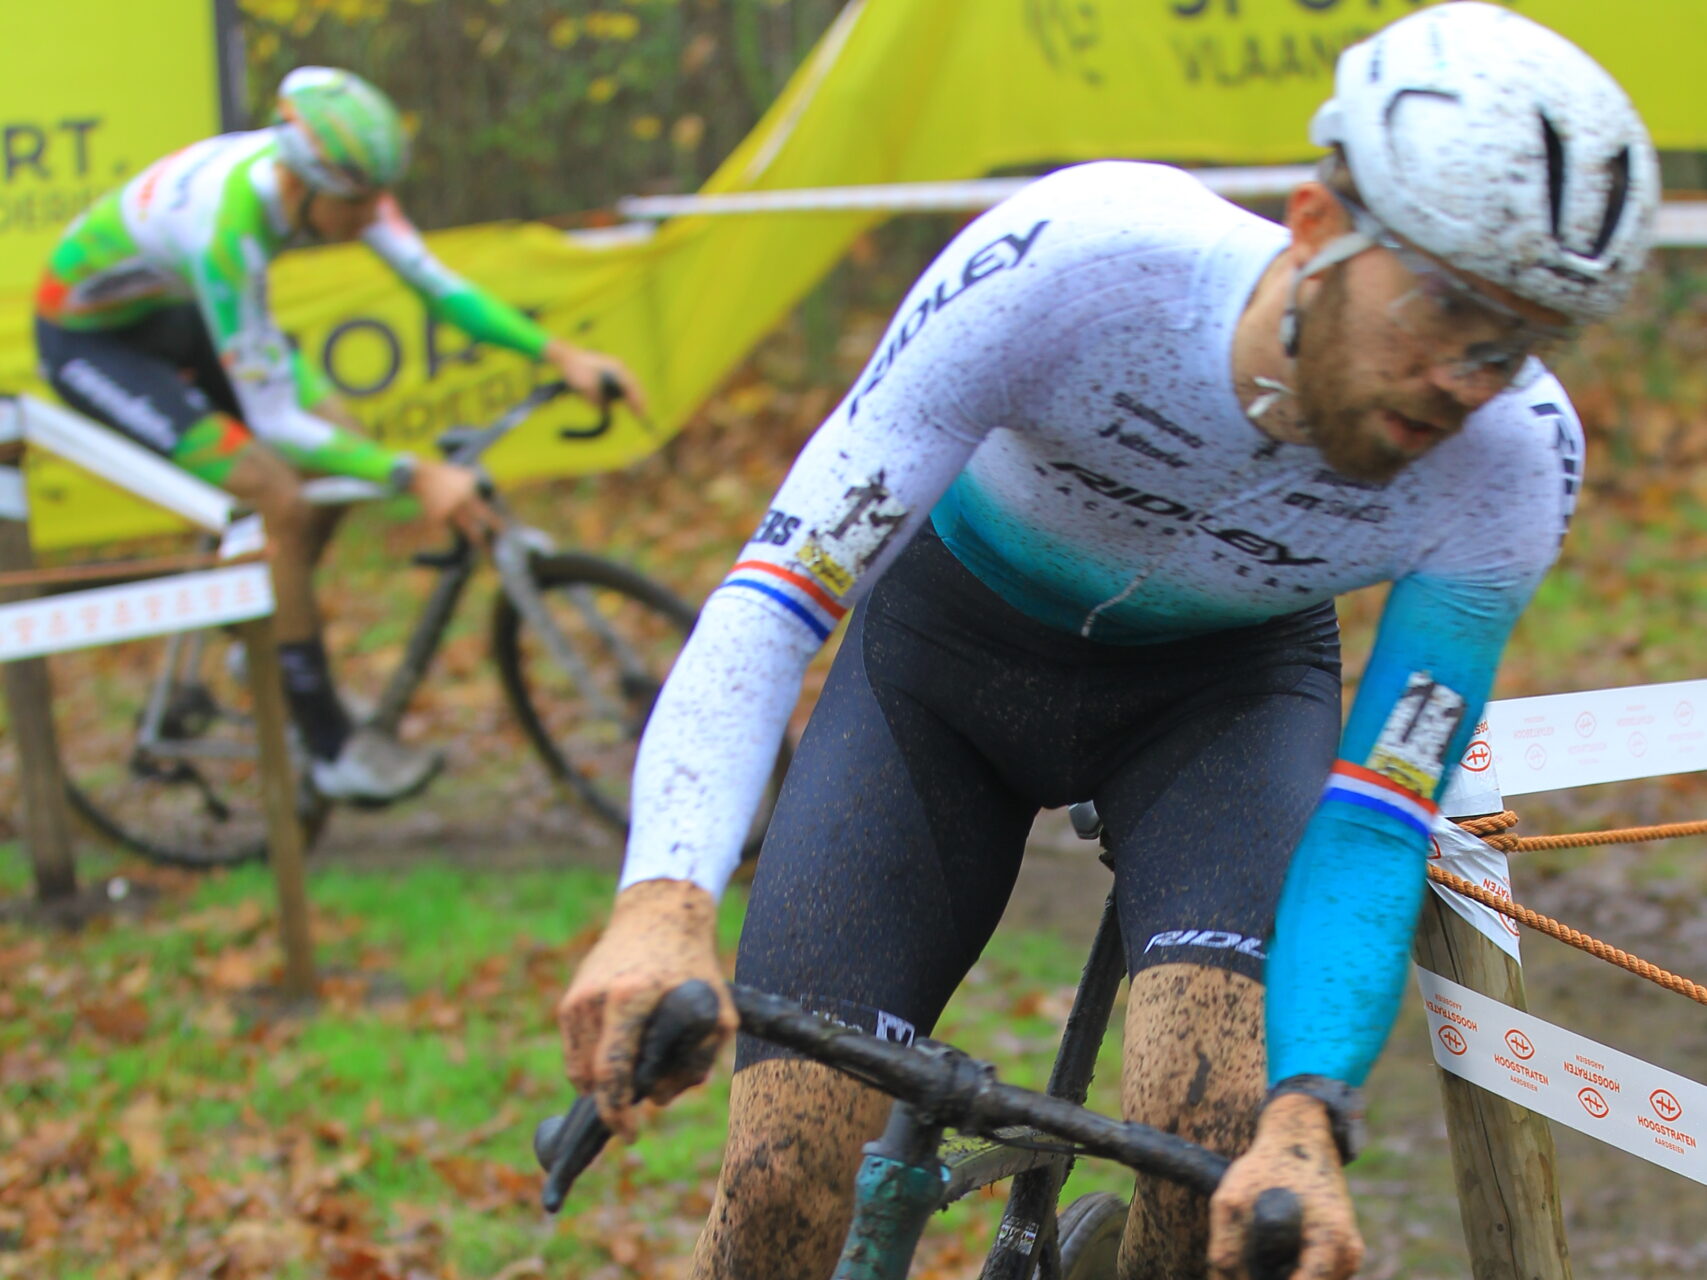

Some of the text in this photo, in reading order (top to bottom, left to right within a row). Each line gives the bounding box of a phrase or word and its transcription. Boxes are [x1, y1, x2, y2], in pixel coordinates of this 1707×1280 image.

[1494, 1054, 1549, 1086] HOOGSTRATEN
[1563, 1061, 1620, 1093] HOOGSTRATEN
[1637, 1115, 1696, 1148] HOOGSTRATEN
